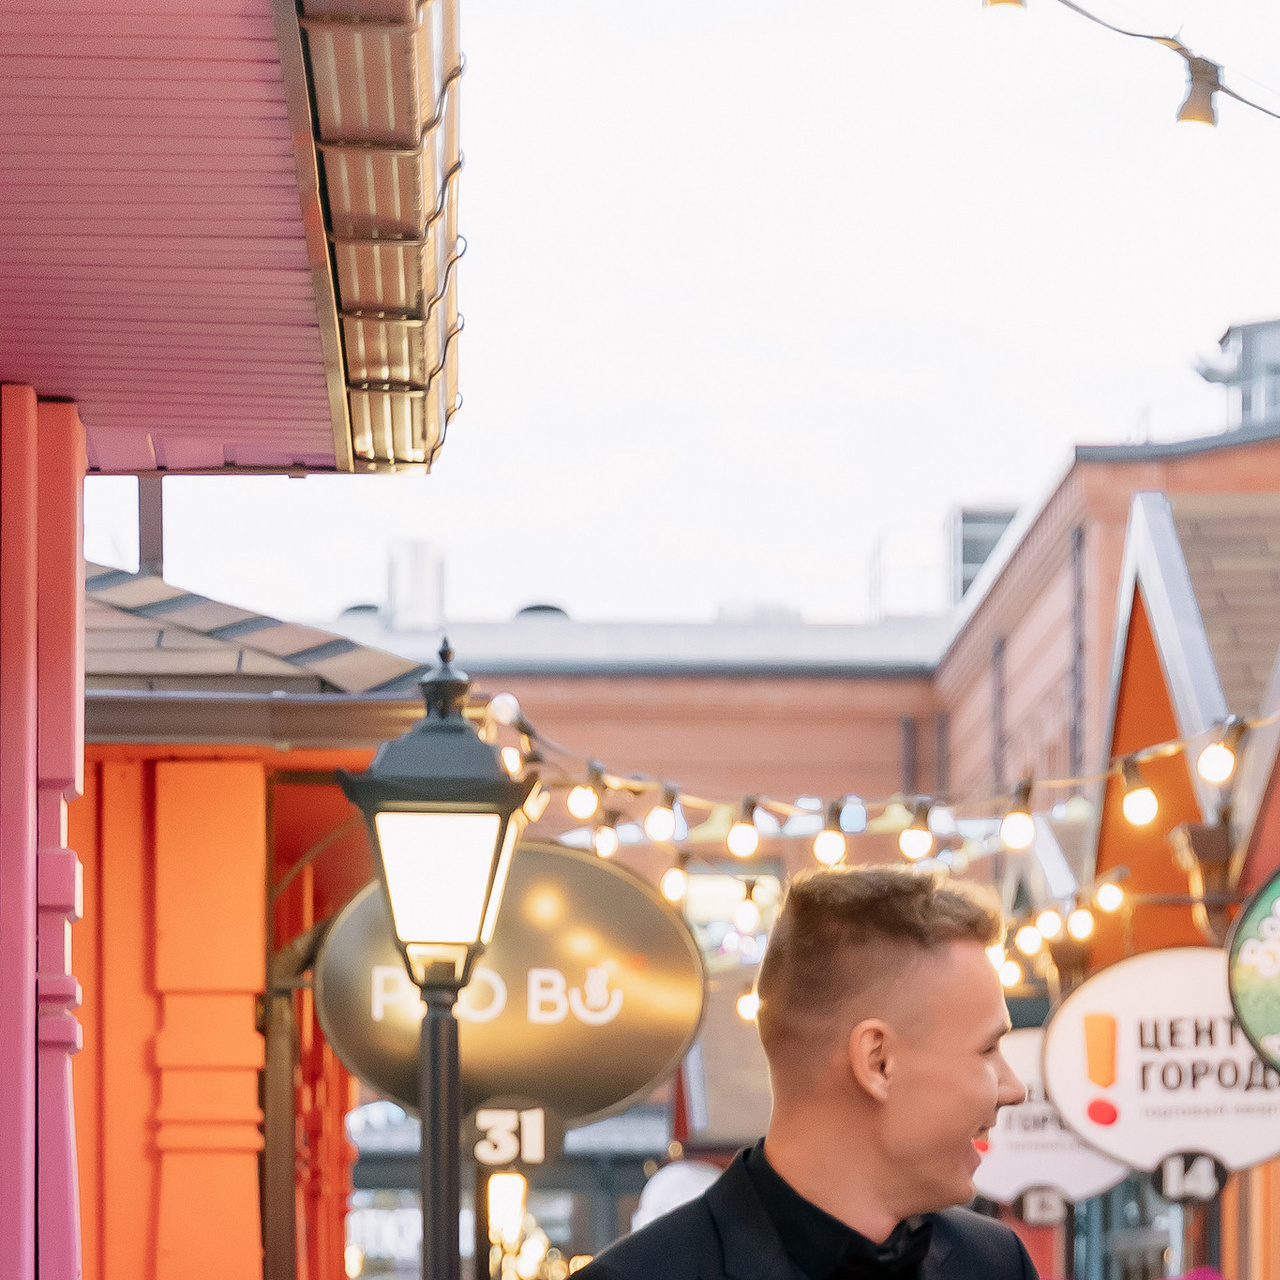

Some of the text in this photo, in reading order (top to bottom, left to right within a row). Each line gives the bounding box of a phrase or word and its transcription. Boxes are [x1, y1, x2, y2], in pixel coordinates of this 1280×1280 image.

[370, 966, 508, 1023] PO
[1138, 1015, 1242, 1052] ЦЕНТ
[474, 1106, 546, 1166] 31
[1162, 1154, 1220, 1201] 14
